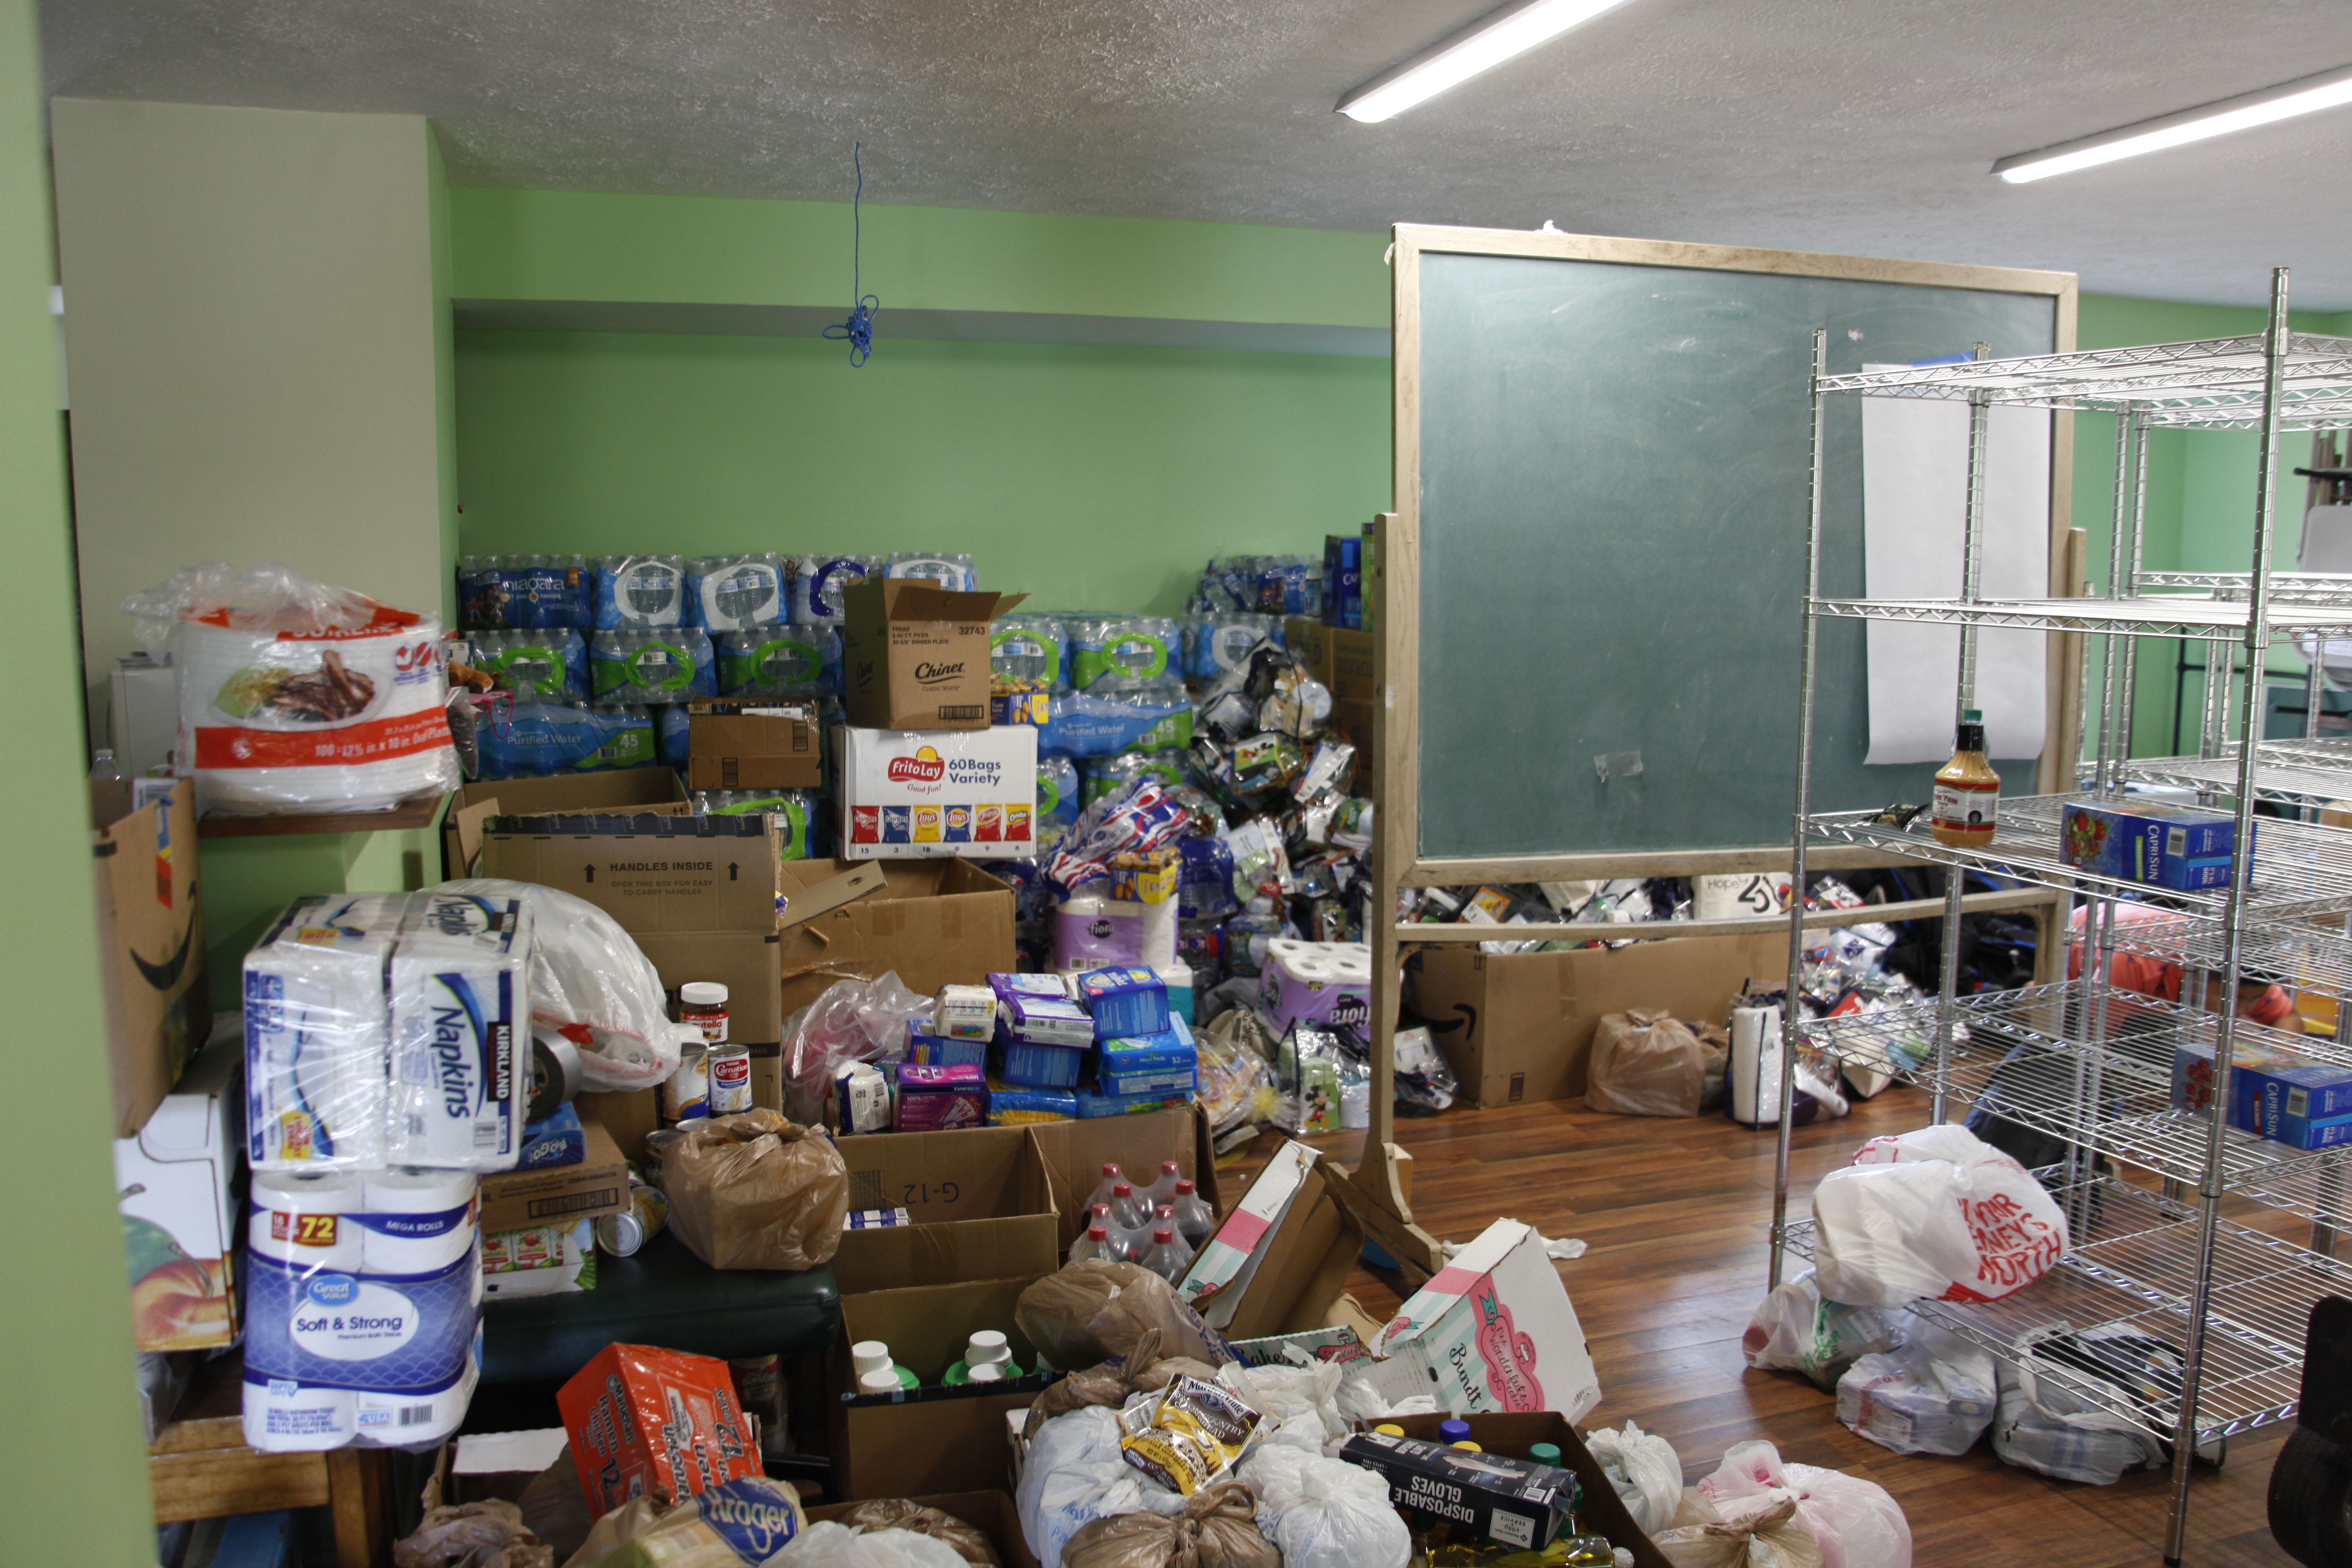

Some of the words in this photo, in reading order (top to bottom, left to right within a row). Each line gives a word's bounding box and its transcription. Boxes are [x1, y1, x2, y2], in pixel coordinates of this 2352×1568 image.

[959, 627, 985, 635] 32743
[915, 662, 965, 679] Chinet
[1058, 727, 1096, 736] Purified
[1097, 724, 1125, 735] Water
[1156, 720, 1175, 733] 45
[507, 734, 549, 745] Purified
[551, 734, 582, 743] Water
[619, 734, 639, 748] 45
[907, 783, 926, 793] Good
[926, 784, 942, 794] fun!
[949, 773, 1001, 787] Variety
[610, 861, 668, 872] HANDLES
[672, 861, 714, 871] INSIDE
[1708, 878, 1738, 891] Hope
[1091, 923, 1114, 935] fiora
[431, 1006, 474, 1119] Napkins
[496, 1025, 511, 1099] KIRKLAND
[716, 1063, 748, 1076] Carnation
[903, 1182, 959, 1204] G-12
[301, 1217, 335, 1238] 72
[386, 1220, 415, 1231] MEGA
[415, 1220, 445, 1232] ROLLS
[313, 1282, 351, 1293] Great
[297, 1317, 328, 1332] Soft
[332, 1317, 344, 1329] &
[349, 1315, 402, 1329] Strong
[1449, 1343, 1481, 1409] Bundt
[614, 1383, 636, 1445] Maruchan
[590, 1406, 606, 1457] Chicken
[598, 1393, 619, 1454] Ramen
[1204, 1413, 1246, 1436] COUNTRY
[714, 1421, 744, 1460] 12
[601, 1455, 621, 1491] 12
[694, 1442, 715, 1491] men
[1411, 1475, 1462, 1503] GLOVES
[1394, 1487, 1475, 1524] DISPOSABLE
[705, 1485, 790, 1554] Kroger
[1499, 1514, 1527, 1527] SERVICE
[1504, 1524, 1520, 1533] FOOD
